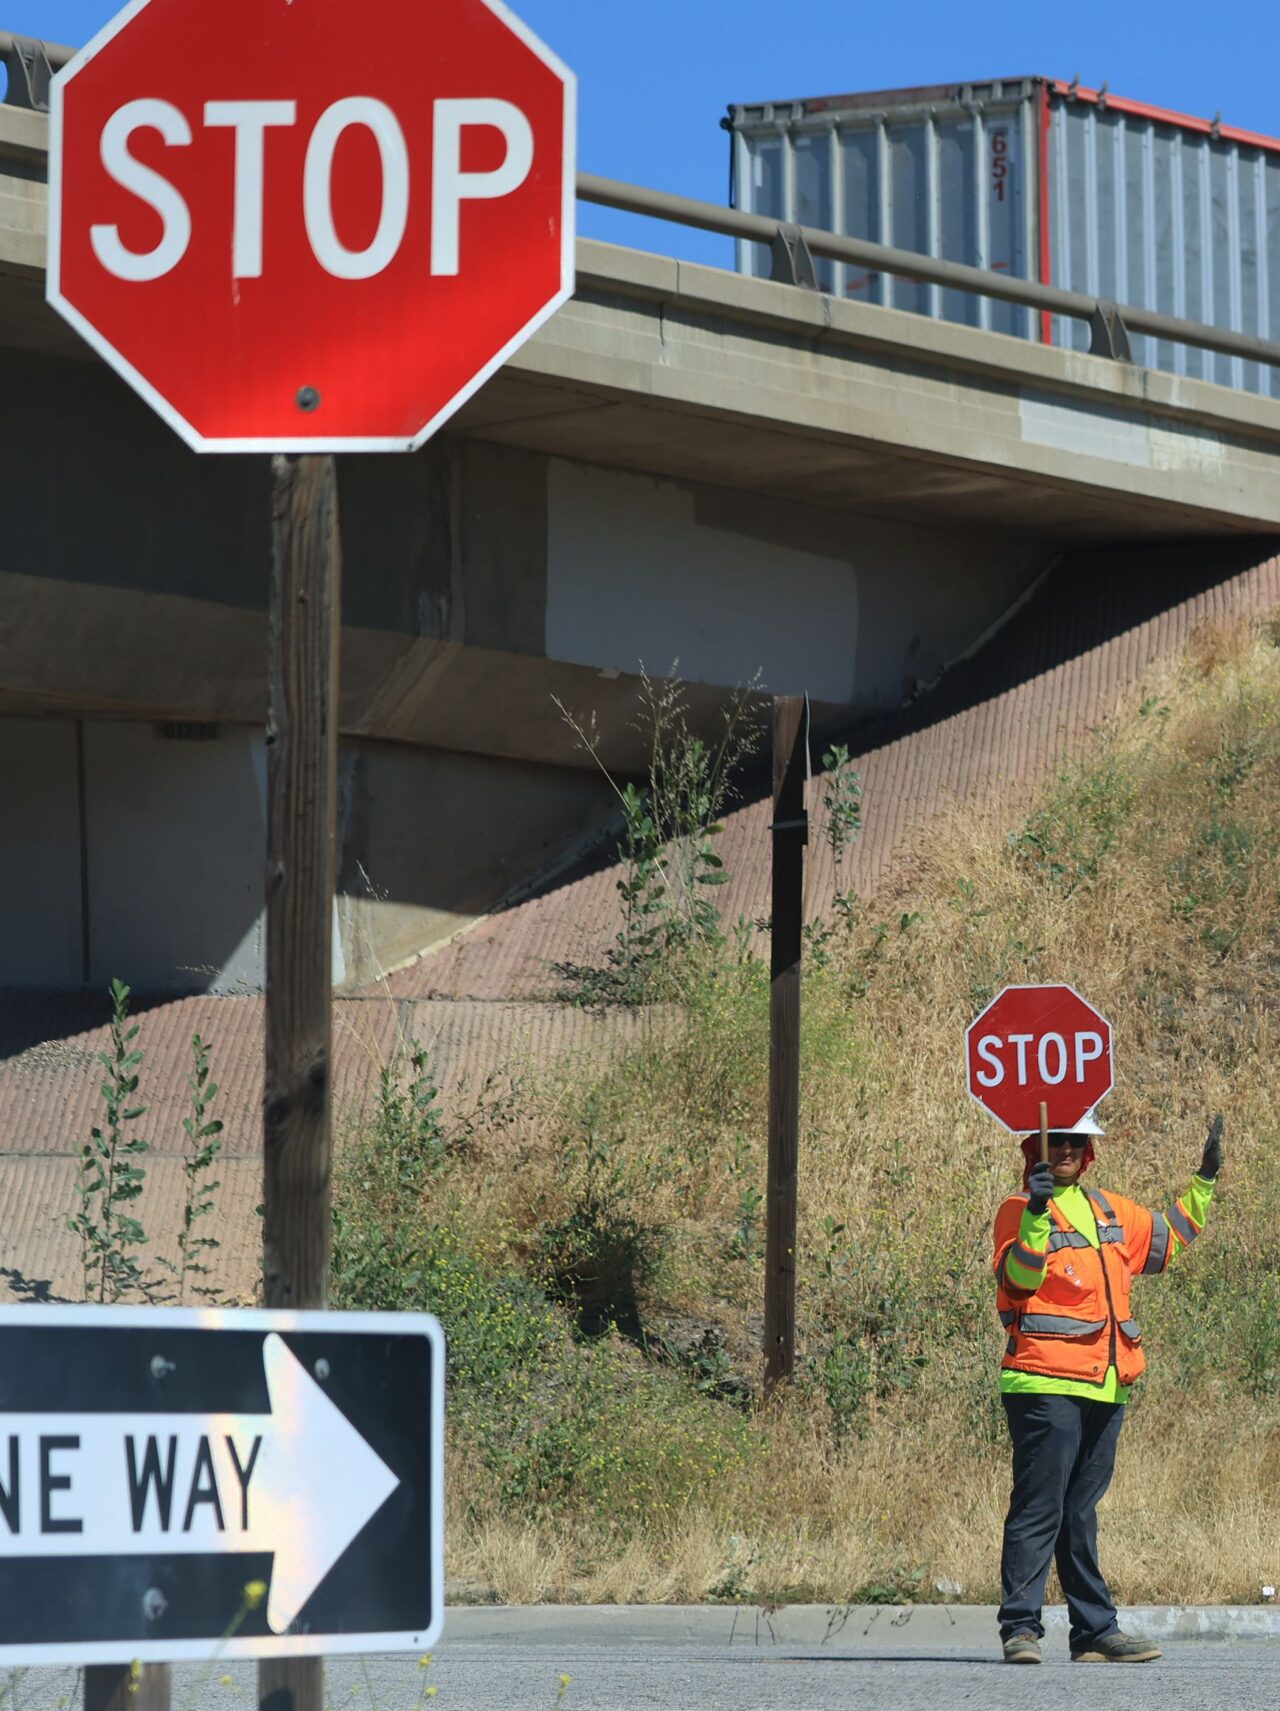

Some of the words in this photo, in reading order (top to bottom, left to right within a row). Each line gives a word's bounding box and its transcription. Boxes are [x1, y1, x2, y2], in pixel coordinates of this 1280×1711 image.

[90, 96, 535, 282] STOP
[992, 131, 1008, 202] 651
[976, 1031, 1103, 1087] STOP
[124, 1435, 263, 1532] WAY
